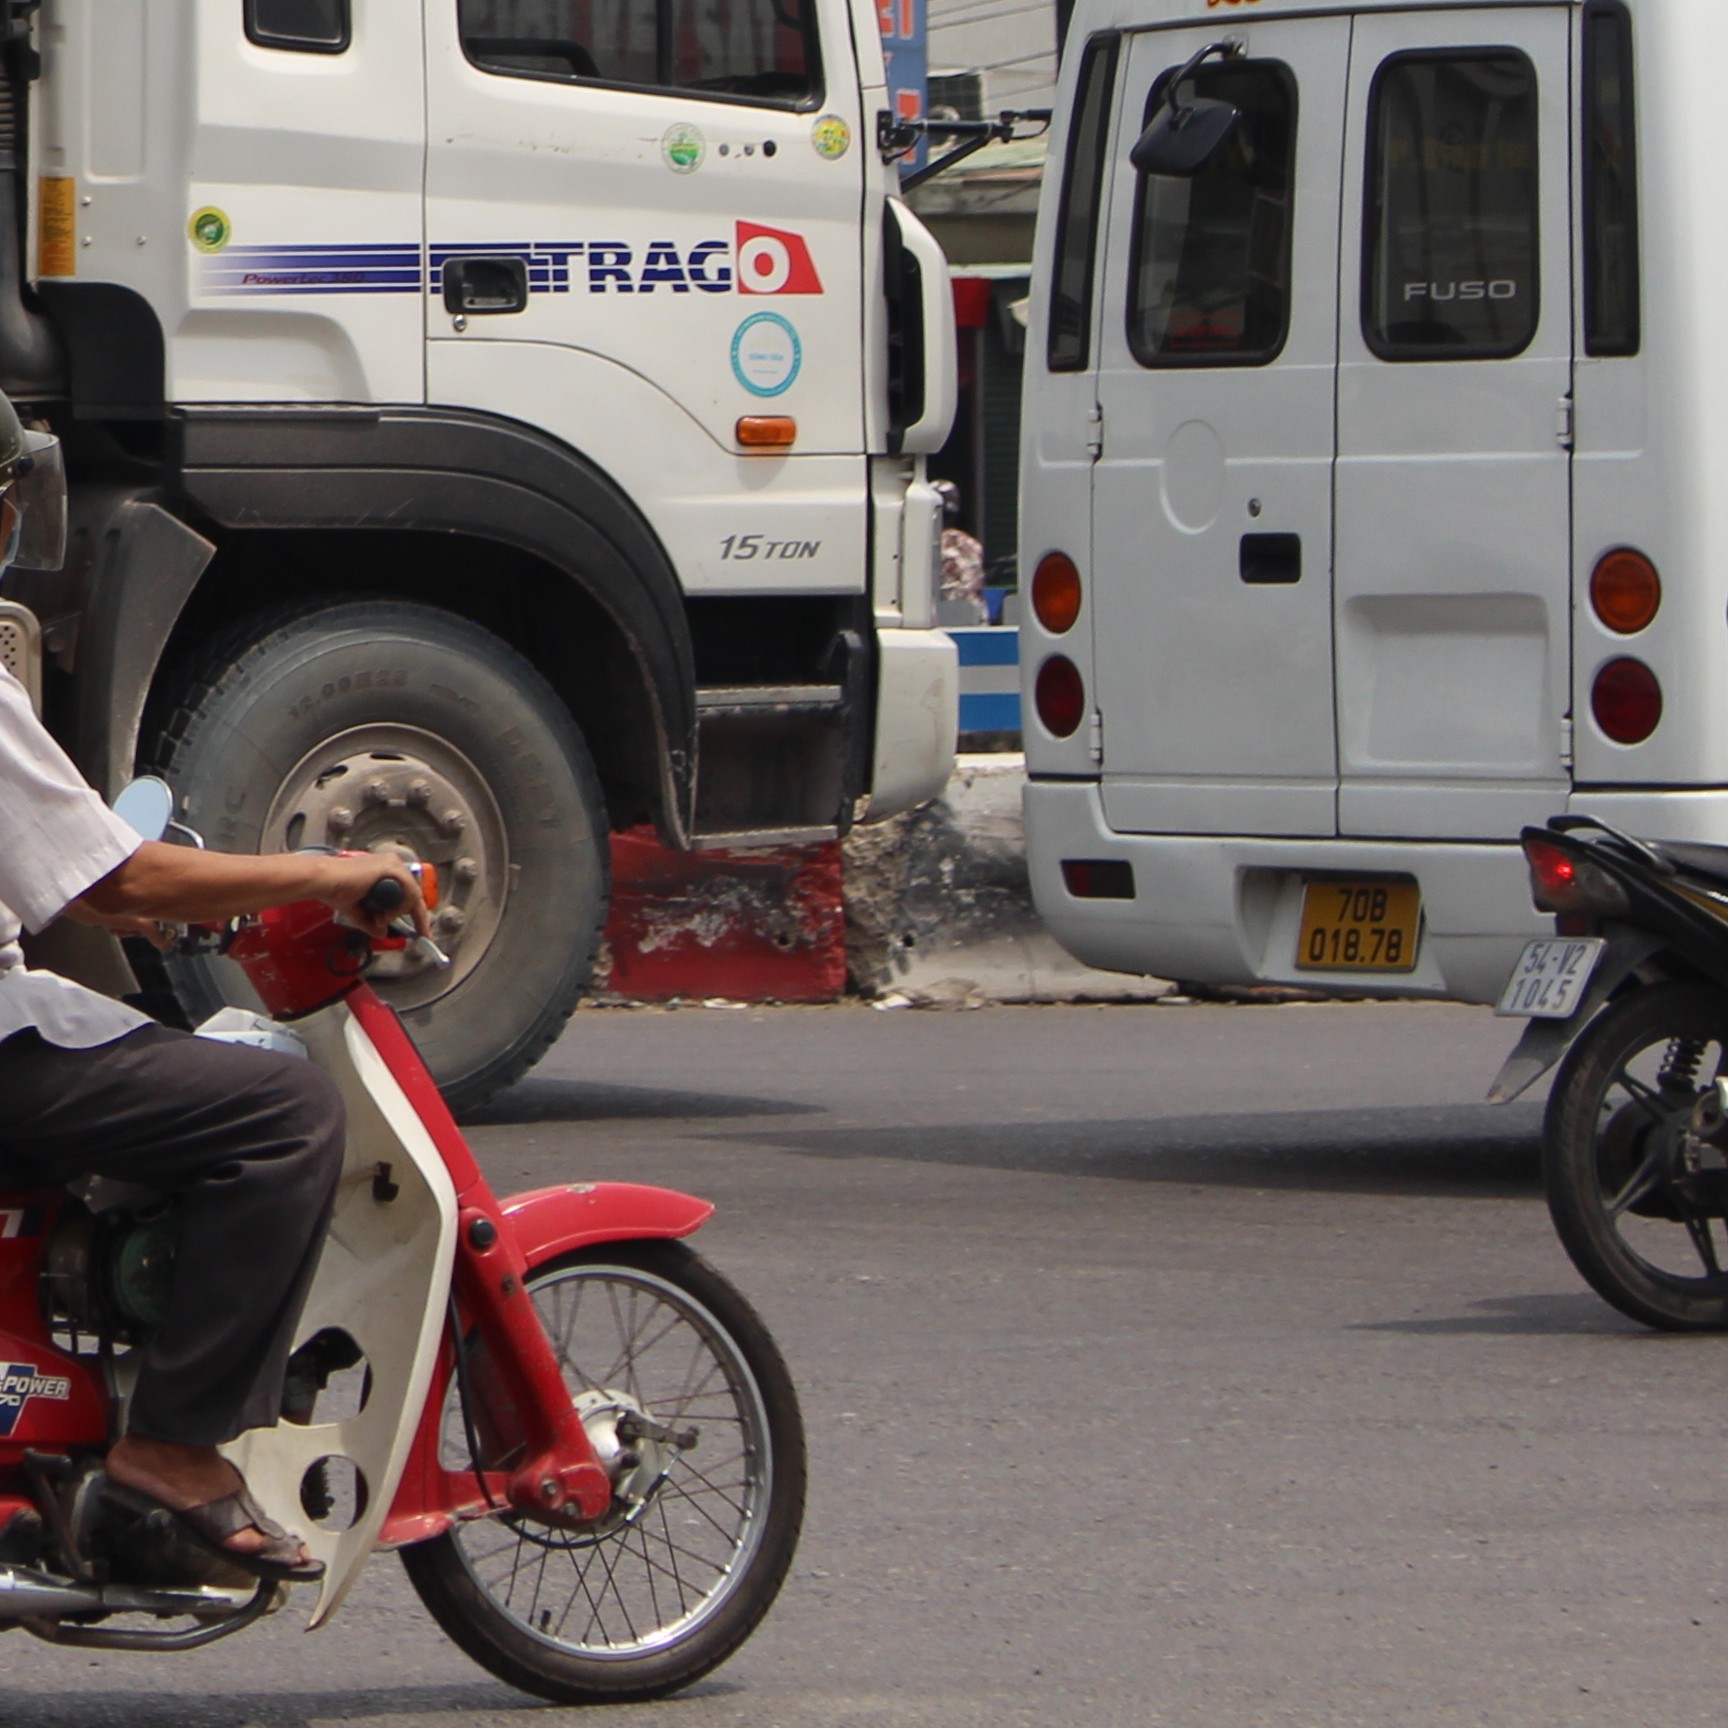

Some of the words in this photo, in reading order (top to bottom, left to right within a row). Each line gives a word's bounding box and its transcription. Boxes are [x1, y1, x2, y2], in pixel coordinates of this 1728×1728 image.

[1404, 280, 1516, 301] FUSO
[720, 534, 765, 560] 15
[764, 540, 821, 559] TON
[1338, 889, 1387, 922] 70B
[1309, 928, 1403, 963] 018.78
